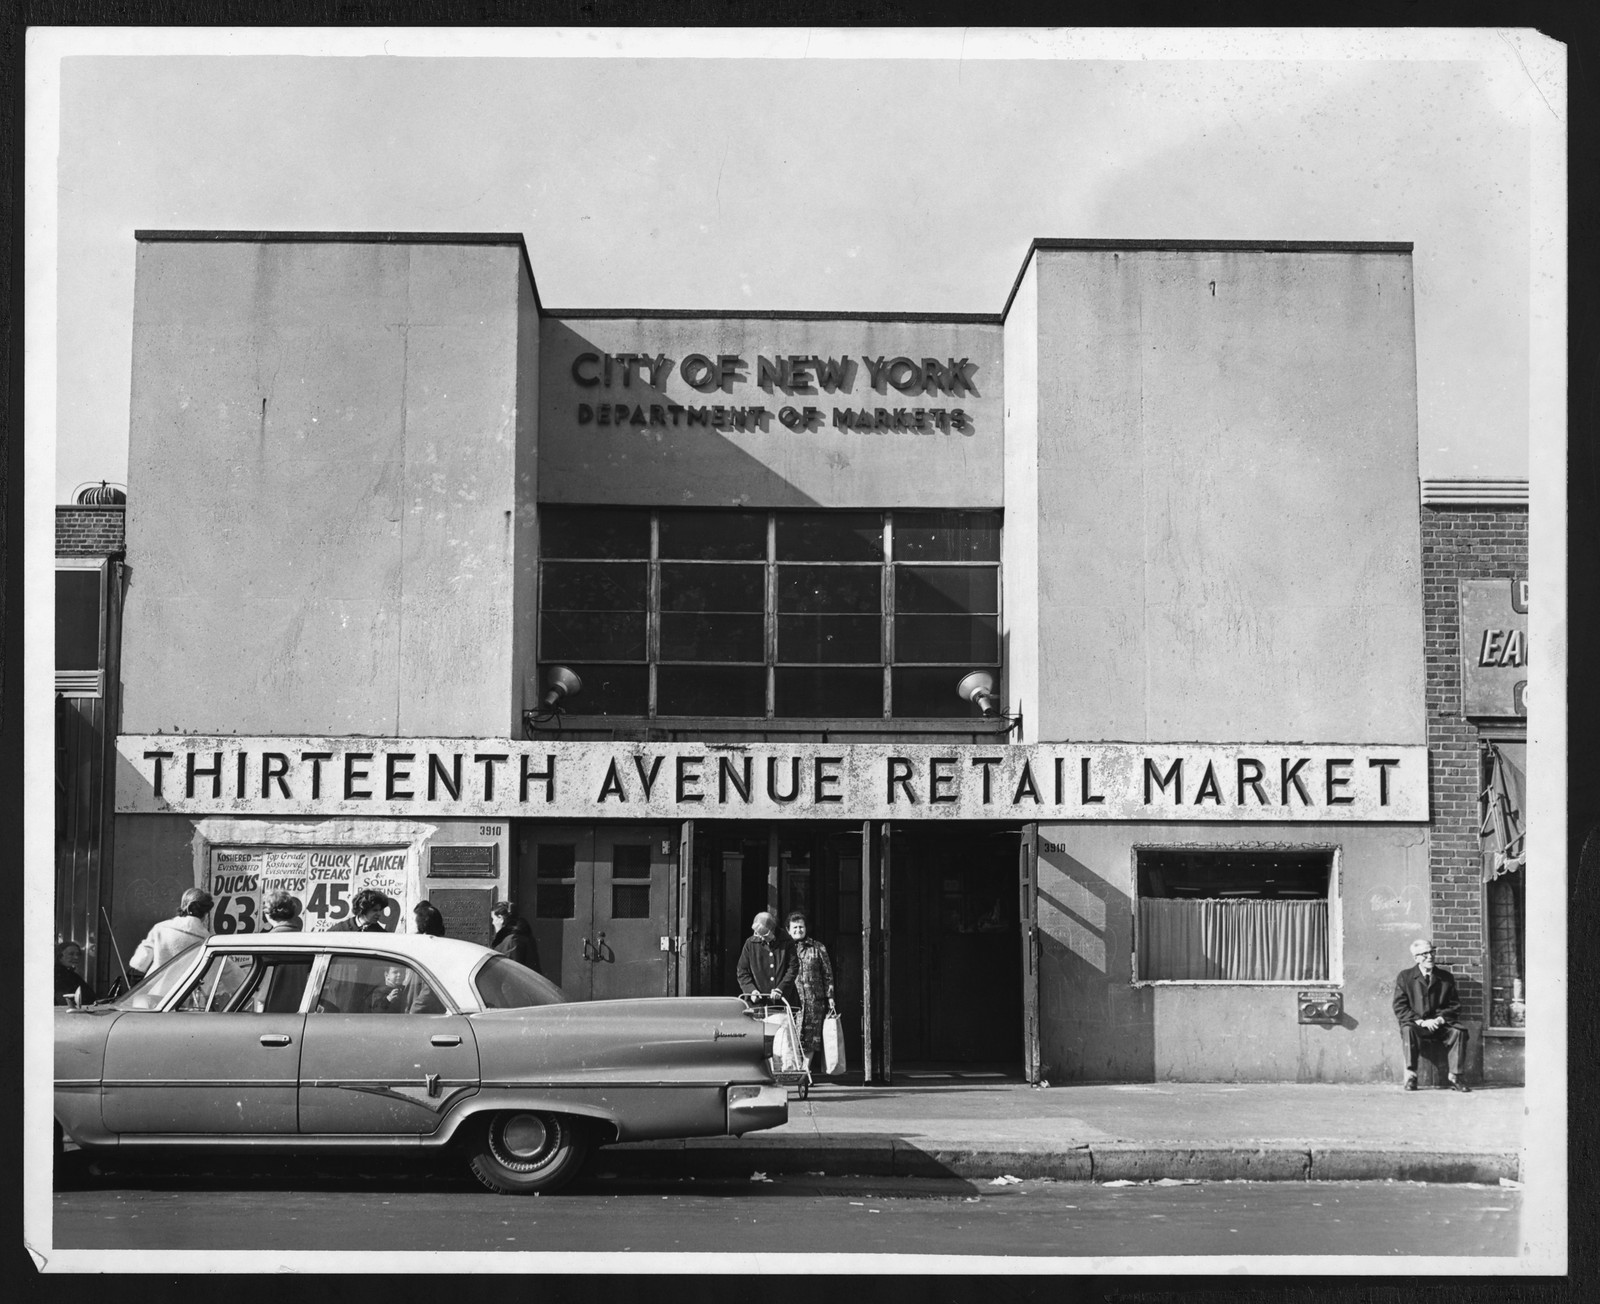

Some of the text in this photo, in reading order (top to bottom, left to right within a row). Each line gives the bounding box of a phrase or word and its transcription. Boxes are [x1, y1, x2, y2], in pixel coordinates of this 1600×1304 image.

[572, 353, 972, 390] CITY OF NEW YORK
[578, 403, 965, 429] DEPARTMENT OF MARKETS
[143, 751, 1401, 806] THIRTEENTH AVENUE RETAIL MARKET
[480, 826, 502, 836] 3910
[266, 852, 280, 861] Top
[1044, 843, 1066, 853] 3910
[217, 853, 252, 862] KOSHERED
[310, 853, 352, 868] CHUCK
[355, 854, 406, 876] FLANKEN
[309, 868, 352, 880] STEAKS
[363, 878, 395, 887] SOUP
[214, 874, 259, 896] DUCKS
[262, 877, 306, 894] TURKEYS
[306, 883, 350, 920] 45
[213, 896, 255, 934] 63
